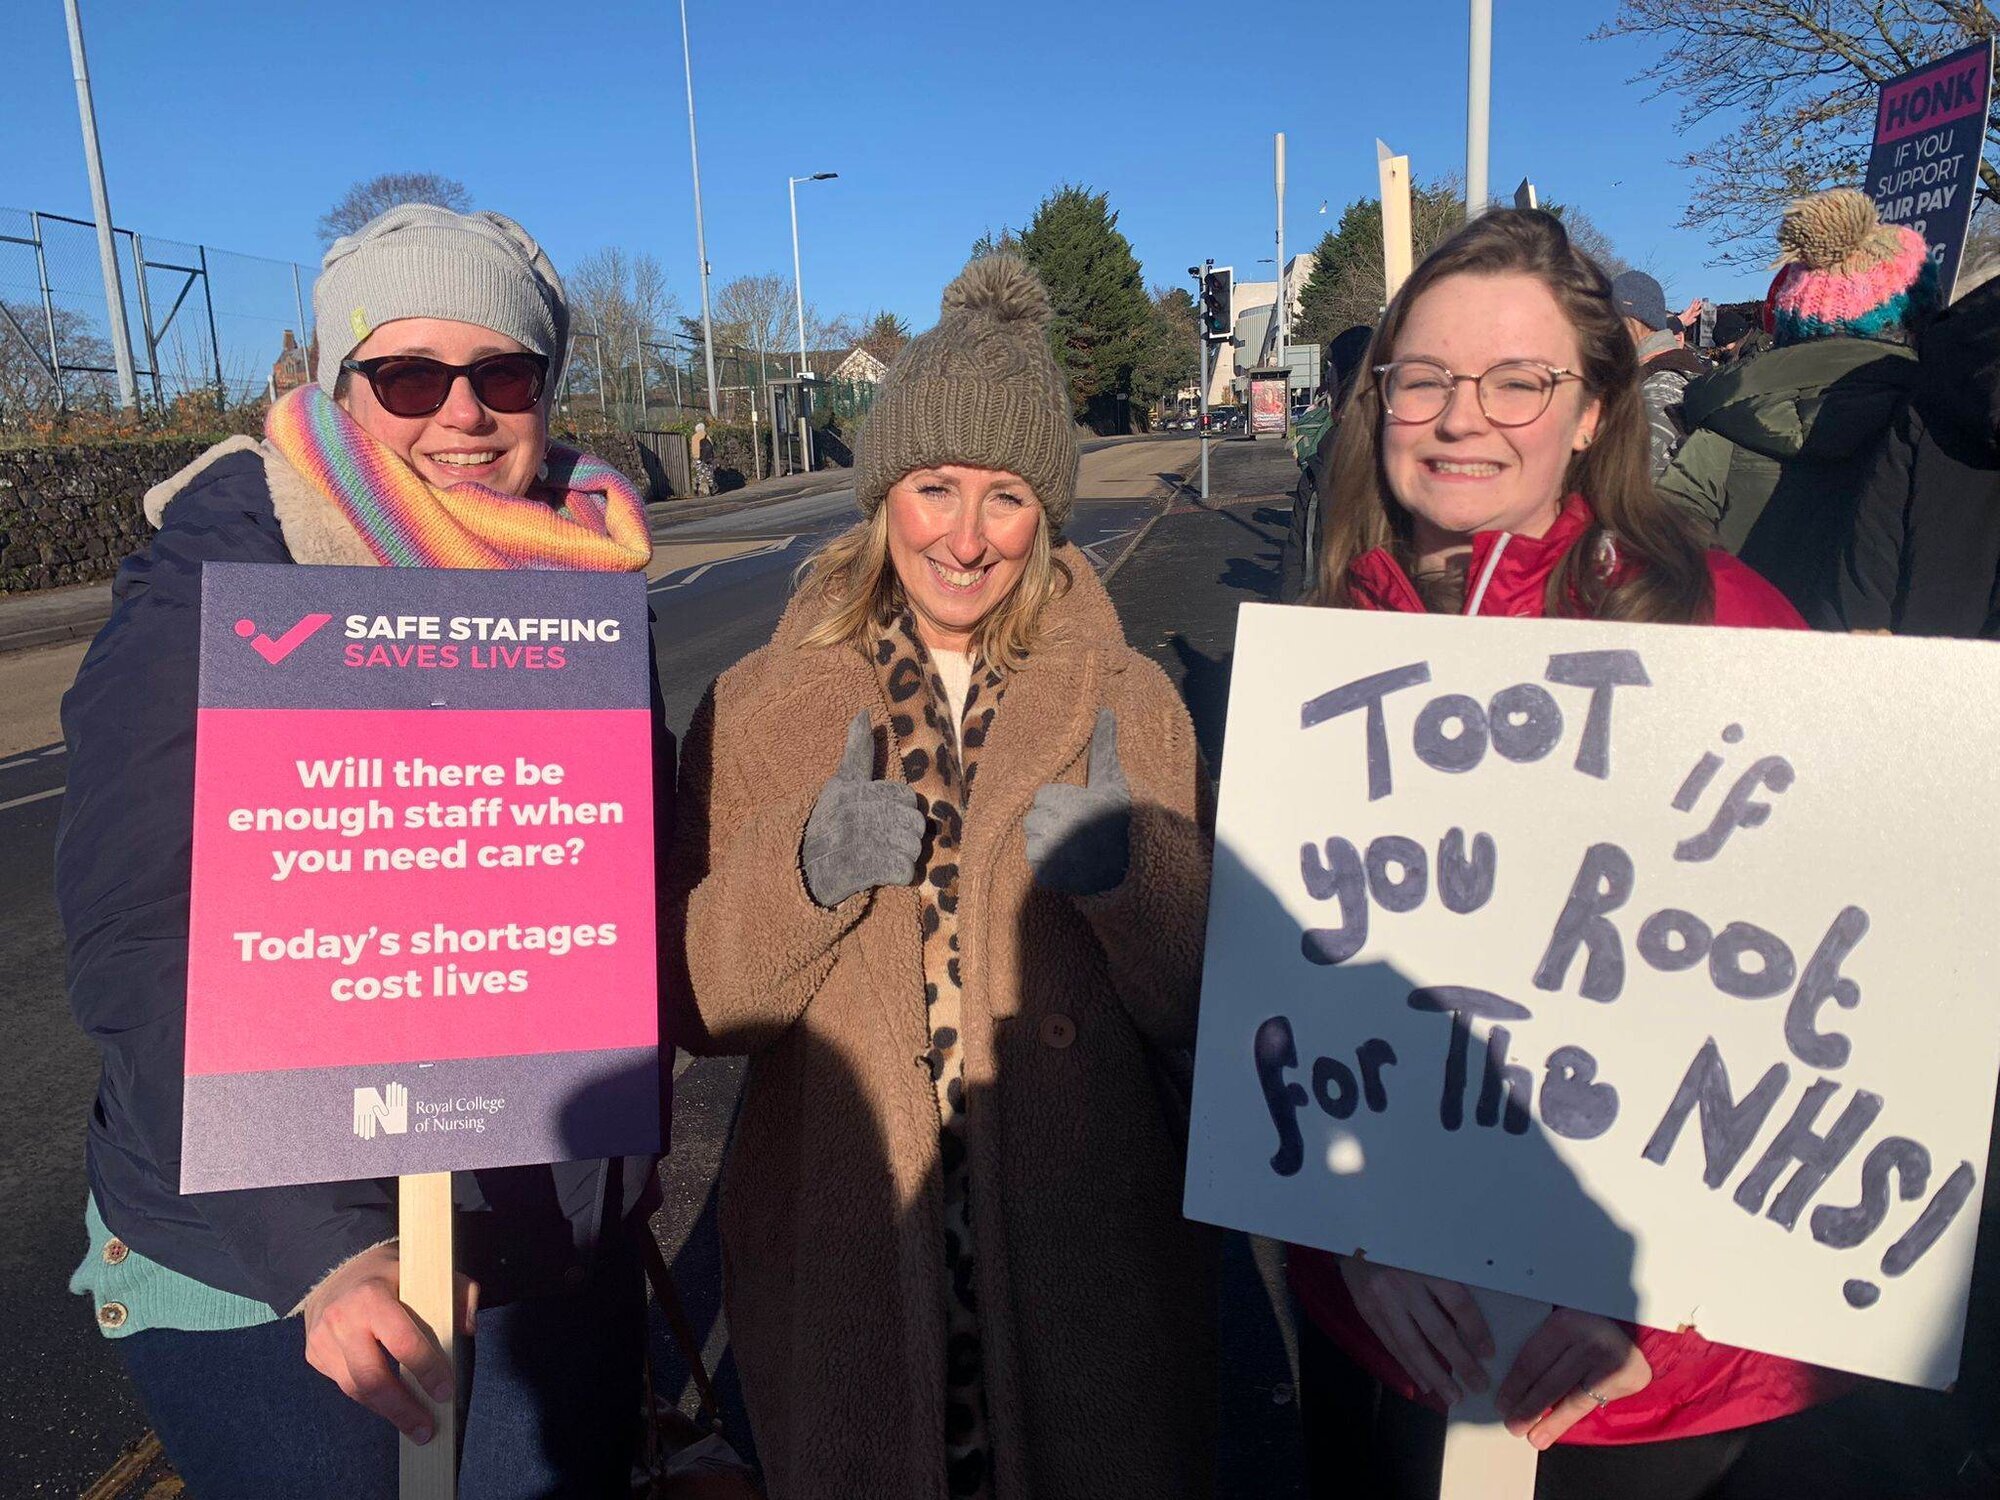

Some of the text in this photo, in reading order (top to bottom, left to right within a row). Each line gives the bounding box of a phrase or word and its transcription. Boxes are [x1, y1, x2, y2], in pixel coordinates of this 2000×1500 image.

[1885, 67, 1976, 132] HONK
[1894, 129, 1954, 168] IF YOU
[1876, 154, 1964, 198] SUPPORT
[1916, 184, 1958, 214] PAY
[344, 614, 621, 643] SAFE STAFFING
[344, 643, 567, 670] SAVES LIVES
[295, 756, 565, 788] Will there be
[1670, 722, 1796, 863] if
[228, 796, 624, 837] enough staff when
[271, 837, 585, 882] you need care?
[1300, 826, 1497, 966] you
[233, 923, 618, 966] Today’s shortages
[330, 963, 529, 1002] cost lives
[416, 1096, 506, 1119] Royal College
[1254, 1014, 1398, 1177] for
[415, 1116, 486, 1133] of Nursing
